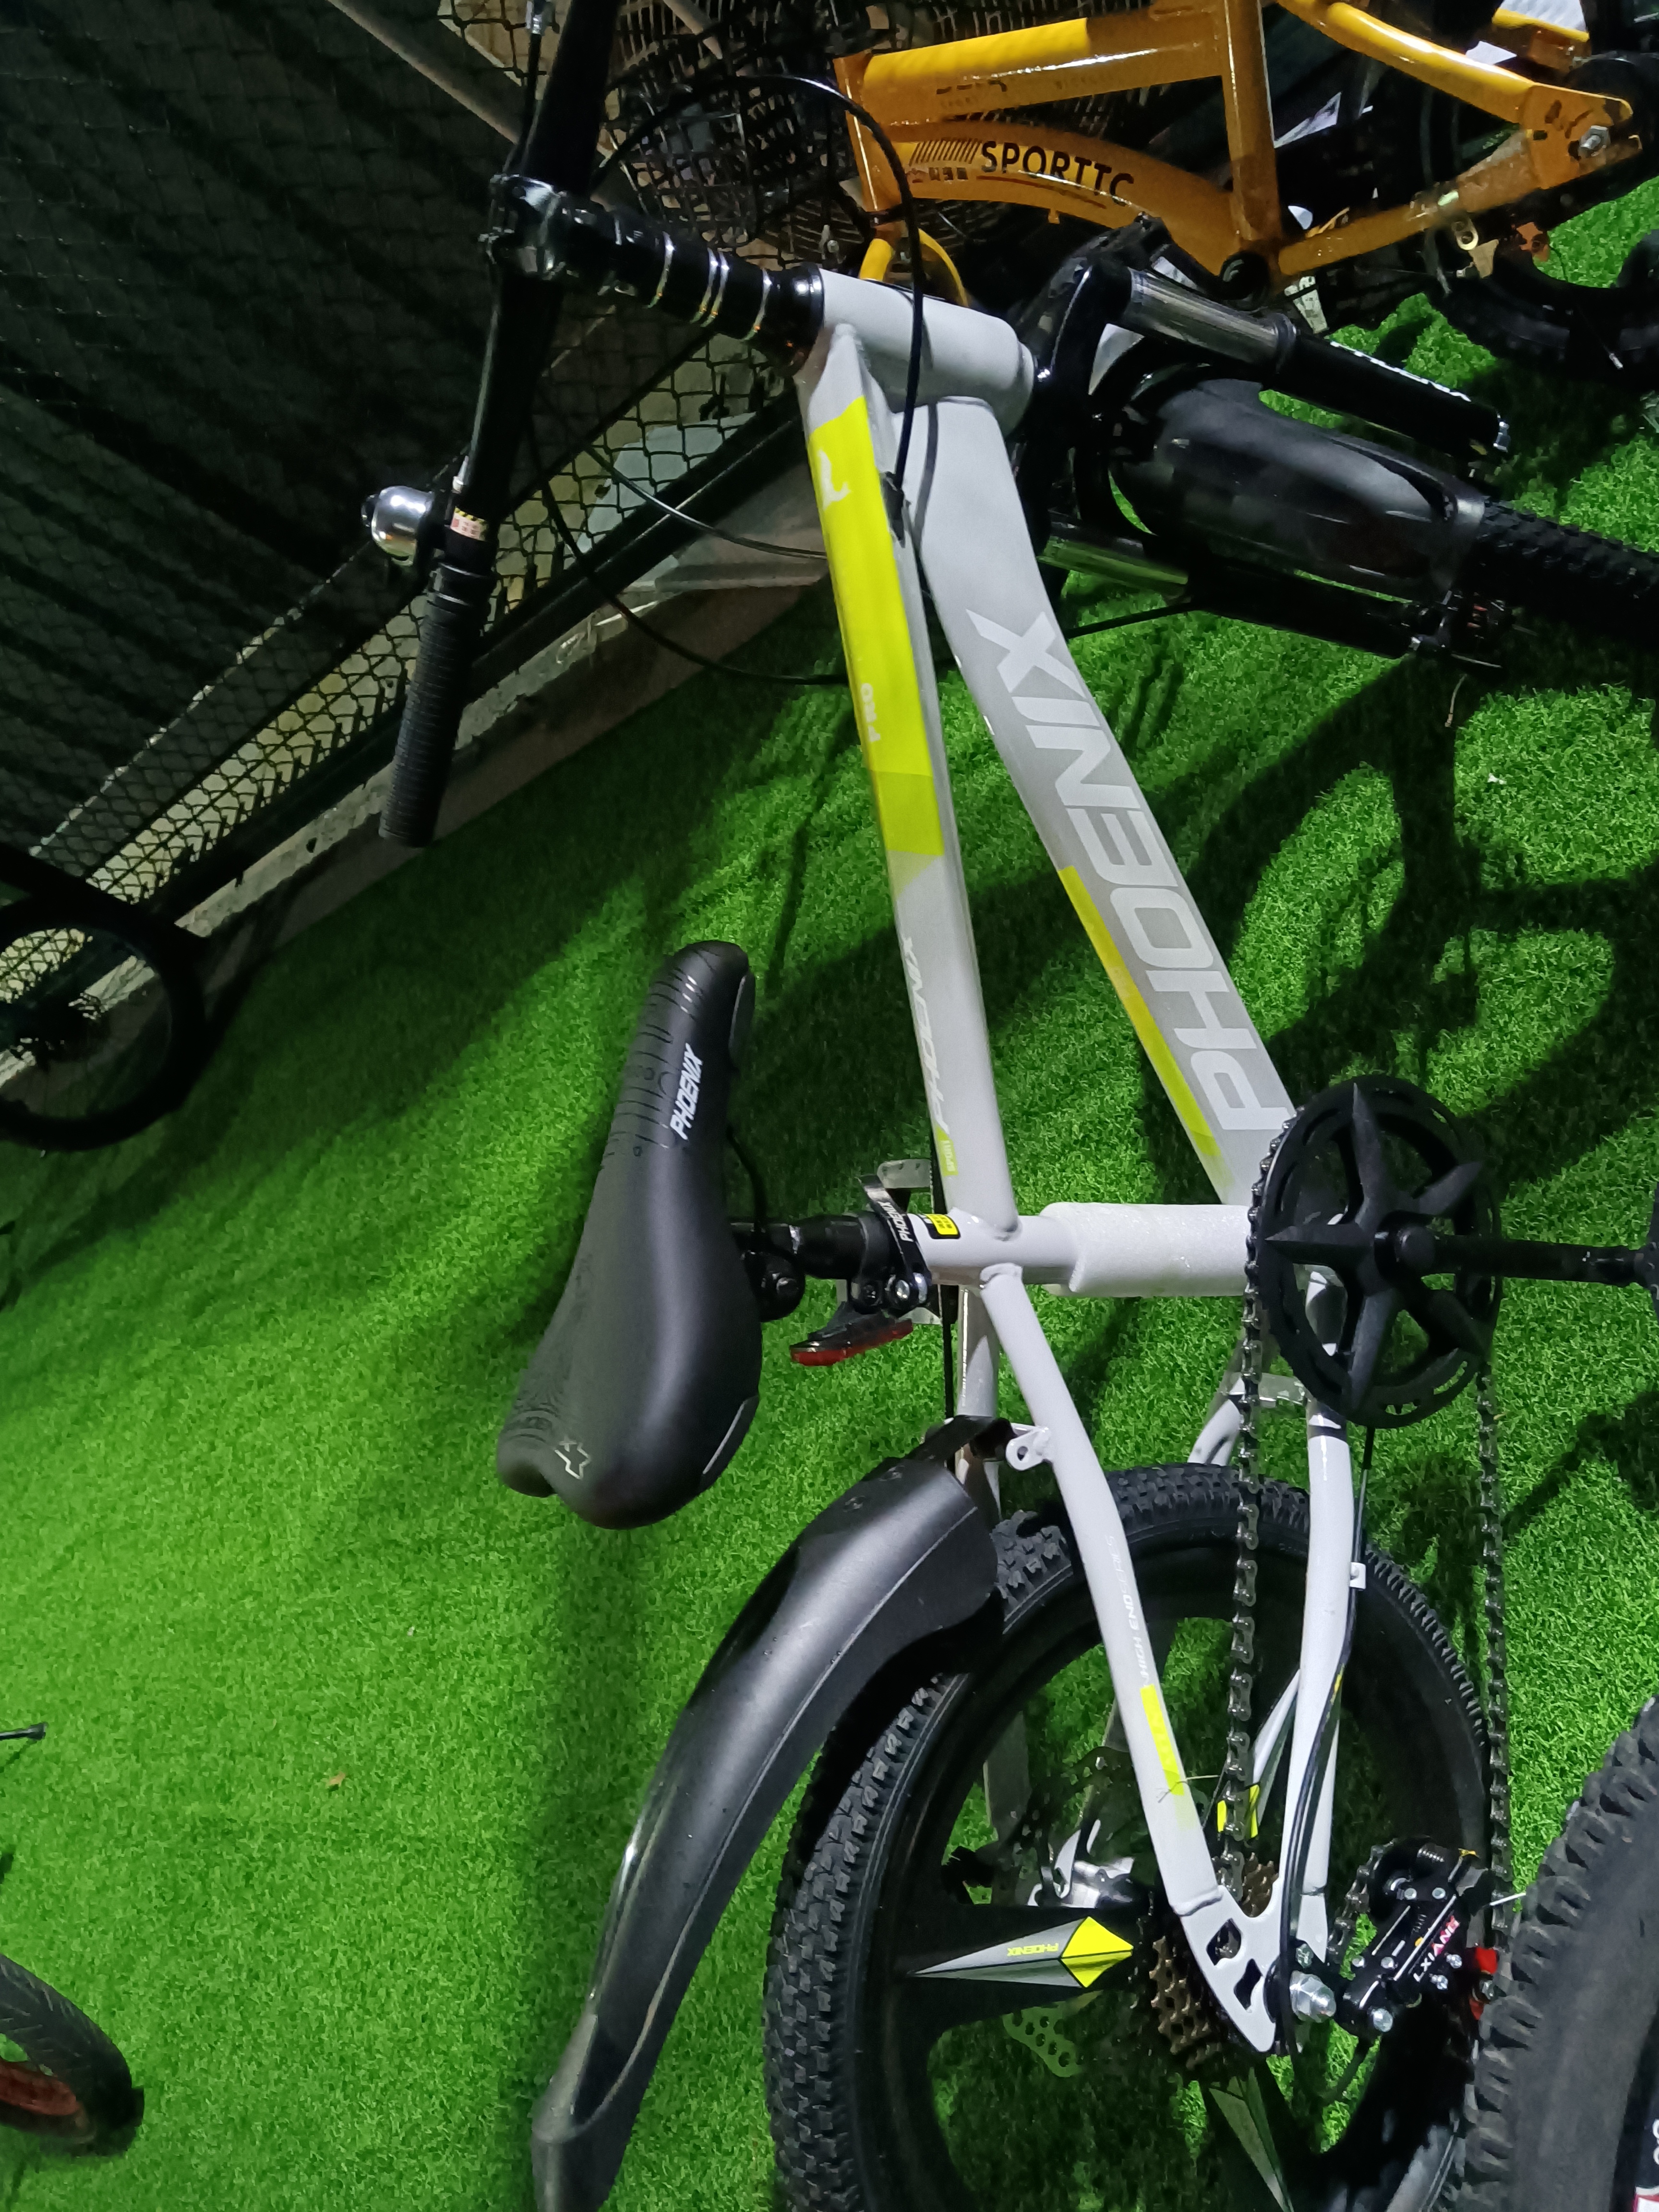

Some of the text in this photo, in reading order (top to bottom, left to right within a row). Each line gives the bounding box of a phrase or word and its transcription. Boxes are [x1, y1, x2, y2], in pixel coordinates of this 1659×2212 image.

[981, 140, 1134, 206] SPORTTC
[966, 609, 1296, 1130] PHOENIX
[670, 1042, 704, 1141] PHOENIX
[877, 1201, 914, 1242] PHOENIX
[1122, 1595, 1139, 1630] END
[1007, 1942, 1058, 1957] PHOENIX
